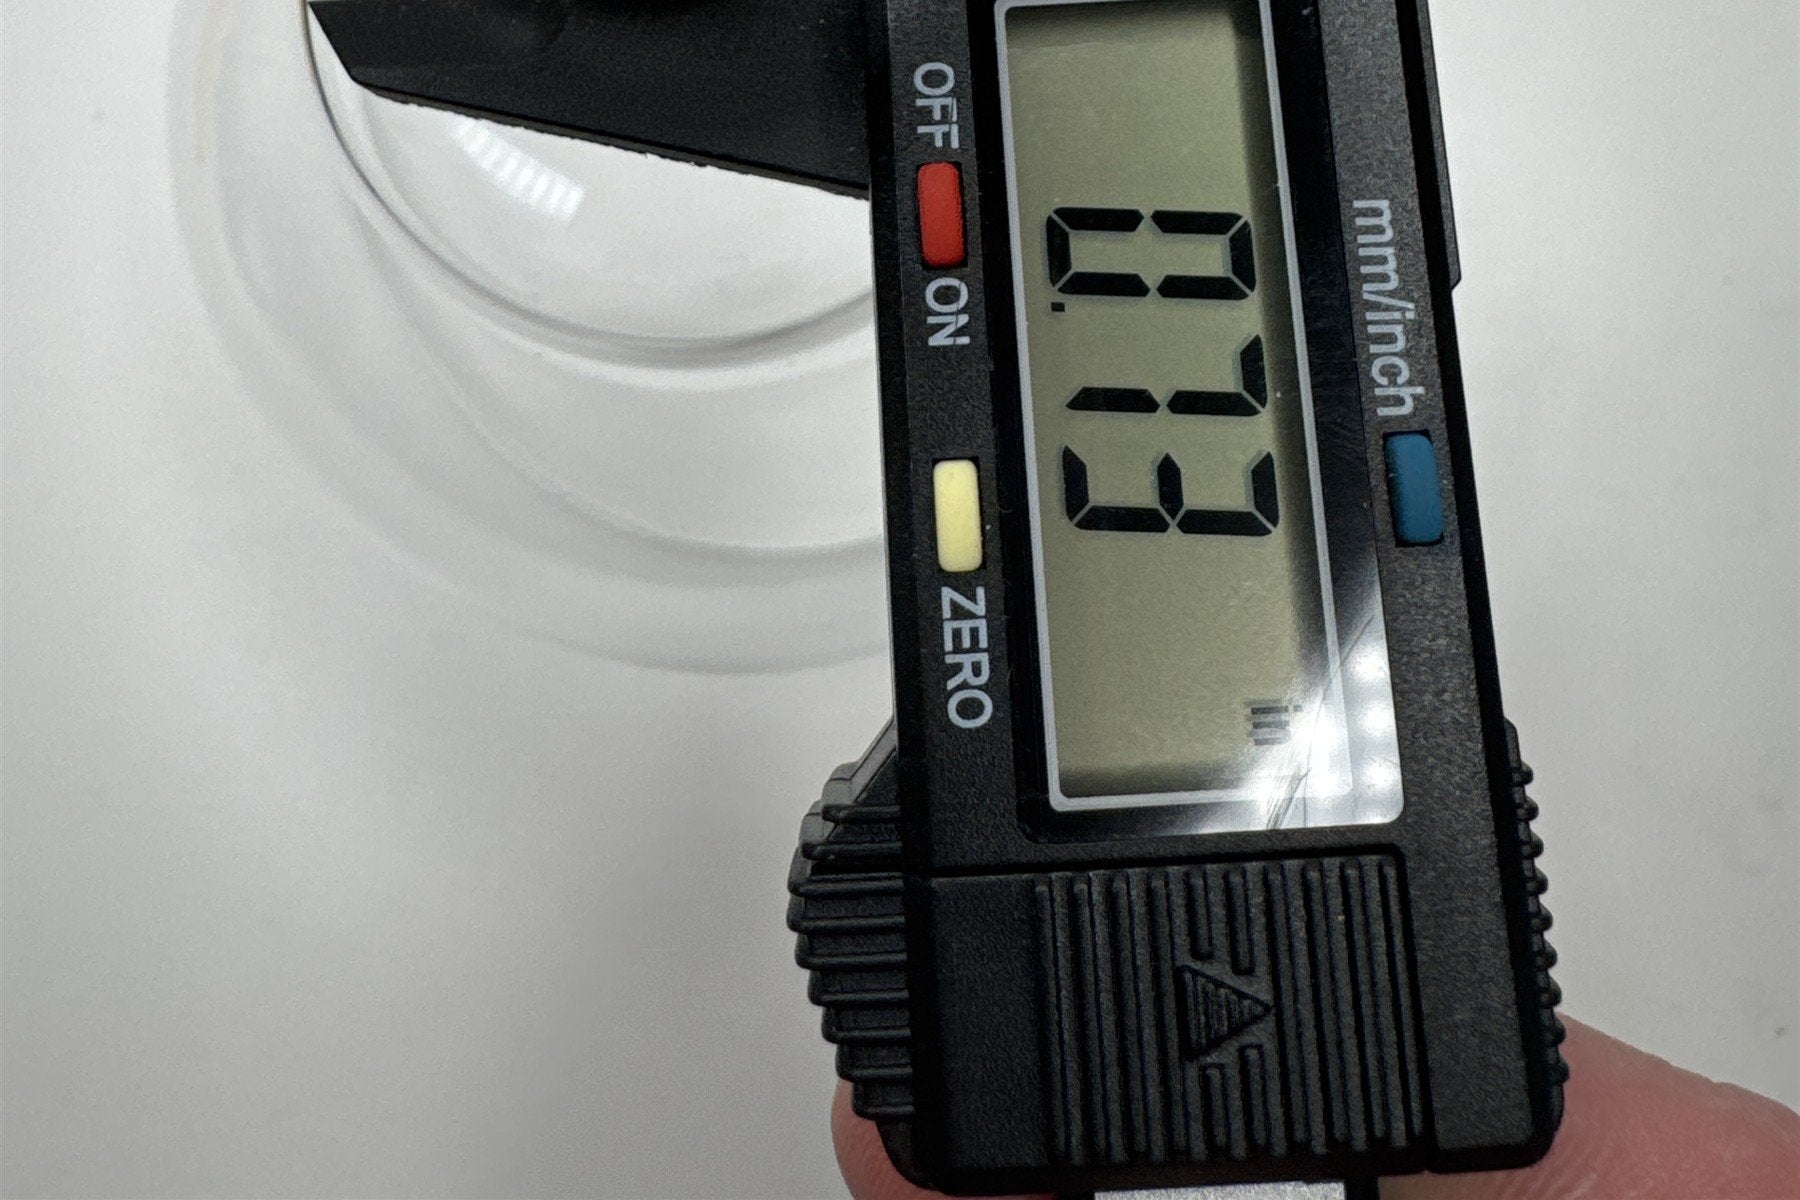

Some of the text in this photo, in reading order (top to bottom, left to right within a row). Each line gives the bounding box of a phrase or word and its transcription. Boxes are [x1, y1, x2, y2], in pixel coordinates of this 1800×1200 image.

[913, 61, 960, 150] OFF
[924, 276, 971, 347] ON
[1046, 207, 1281, 538] 0.73
[1352, 199, 1426, 417] mm/inch
[940, 585, 993, 729] ZERO
